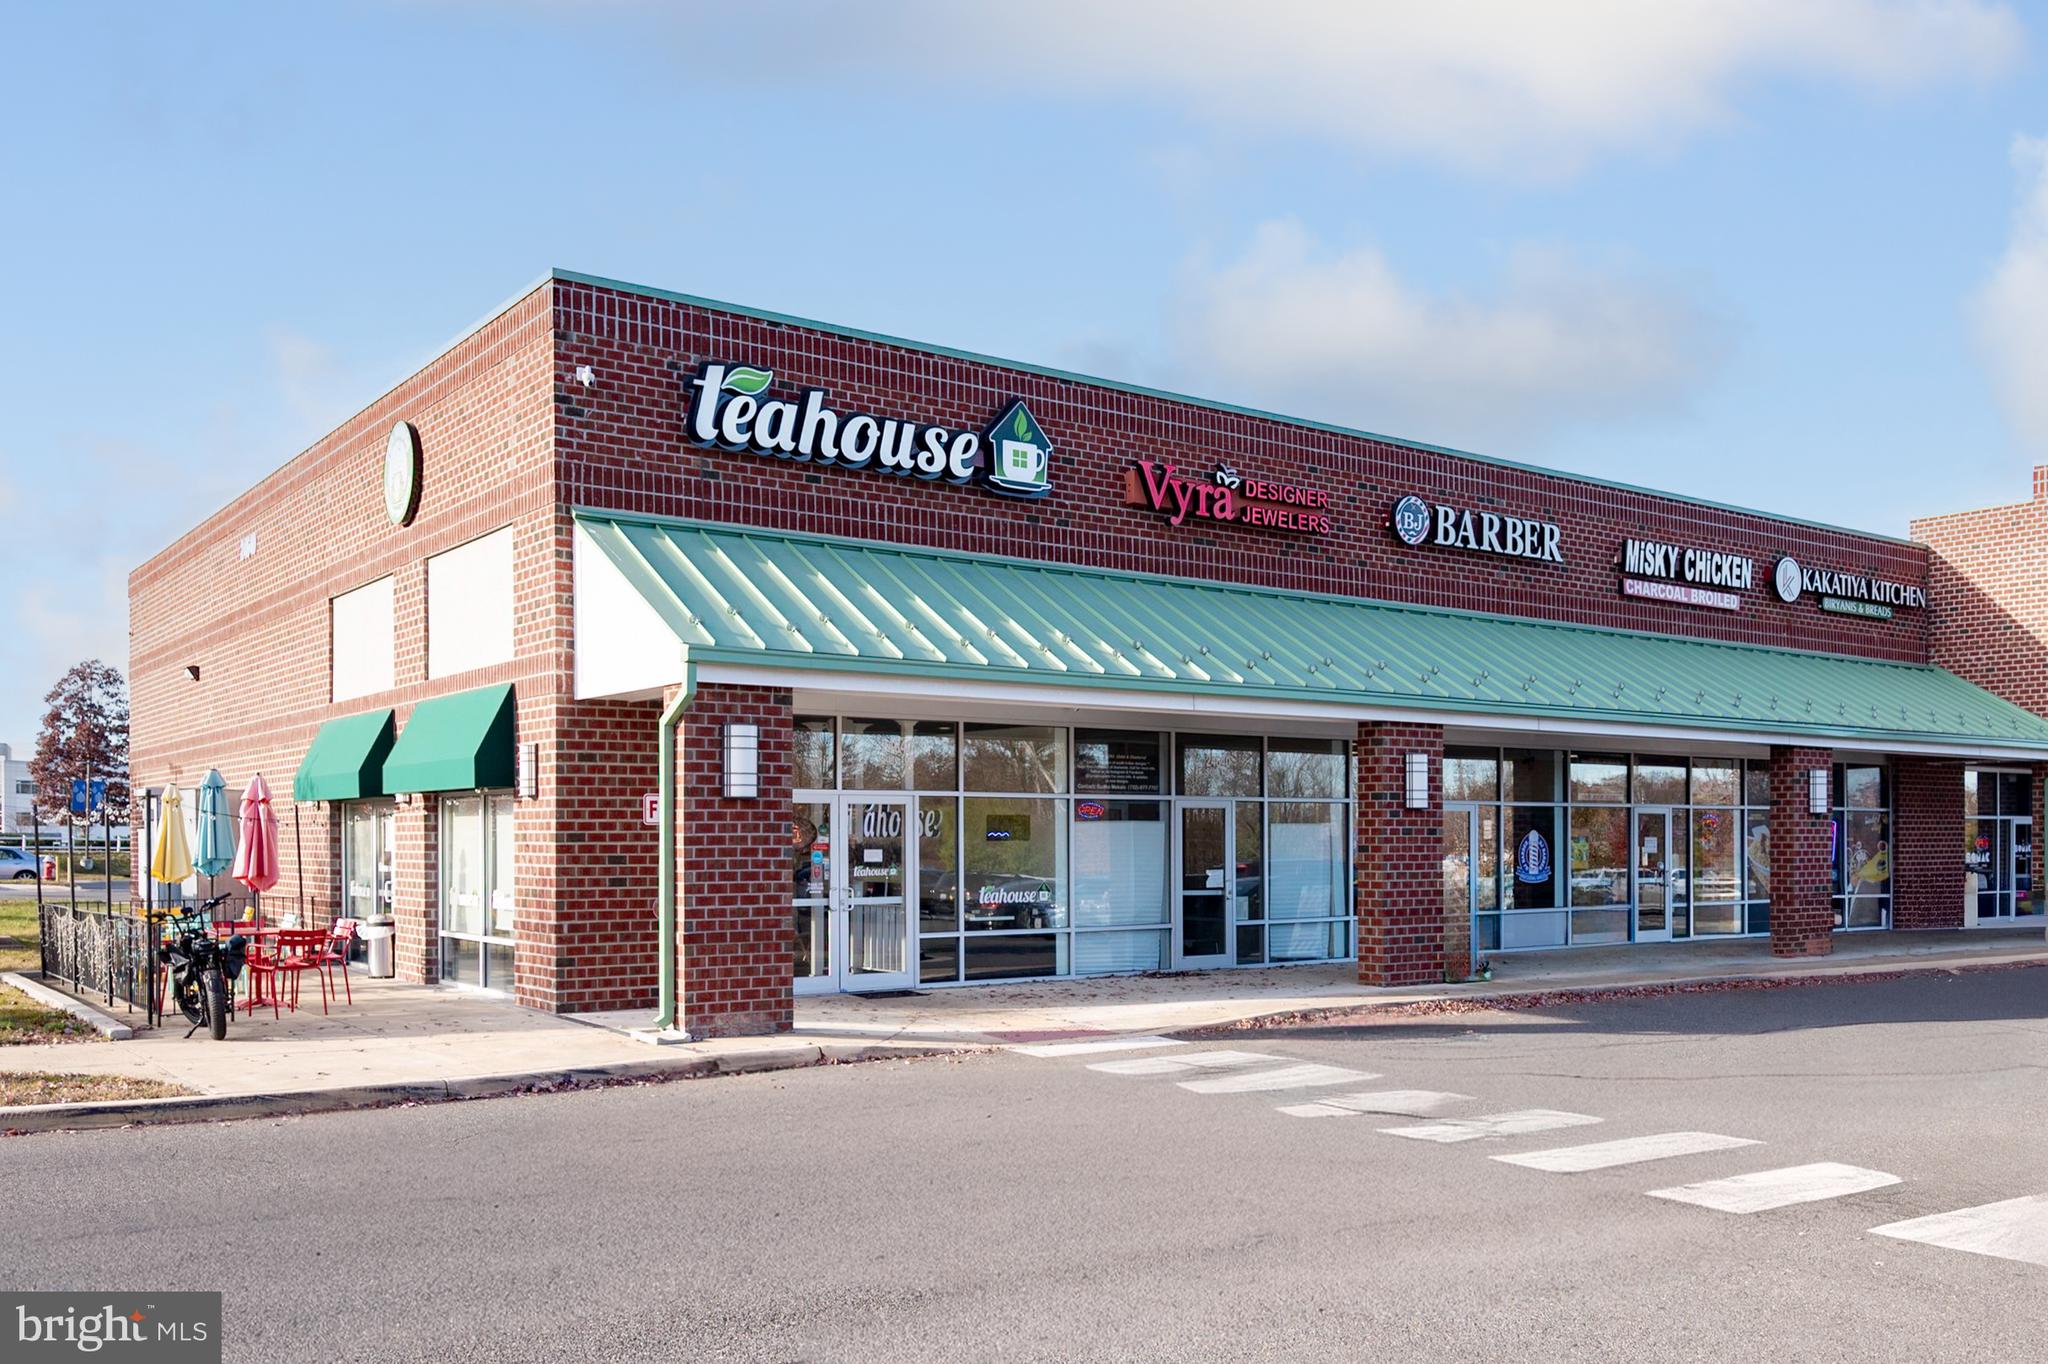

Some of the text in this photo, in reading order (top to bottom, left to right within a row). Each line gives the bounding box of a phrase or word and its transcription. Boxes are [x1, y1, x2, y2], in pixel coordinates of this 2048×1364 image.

[692, 365, 979, 478] teahouse
[1138, 460, 1235, 526] Vyra
[1246, 480, 1329, 508] DESIGNER
[1242, 507, 1330, 534] JEWELERS
[1402, 505, 1563, 562] BJ BARBER
[1626, 579, 1738, 609] CHARCOAL BROILED
[1802, 568, 1868, 599] KAKATIYA
[1872, 579, 1927, 608] KITCHEN
[1865, 603, 1892, 618] BREADS
[979, 886, 1037, 905] teahouse
